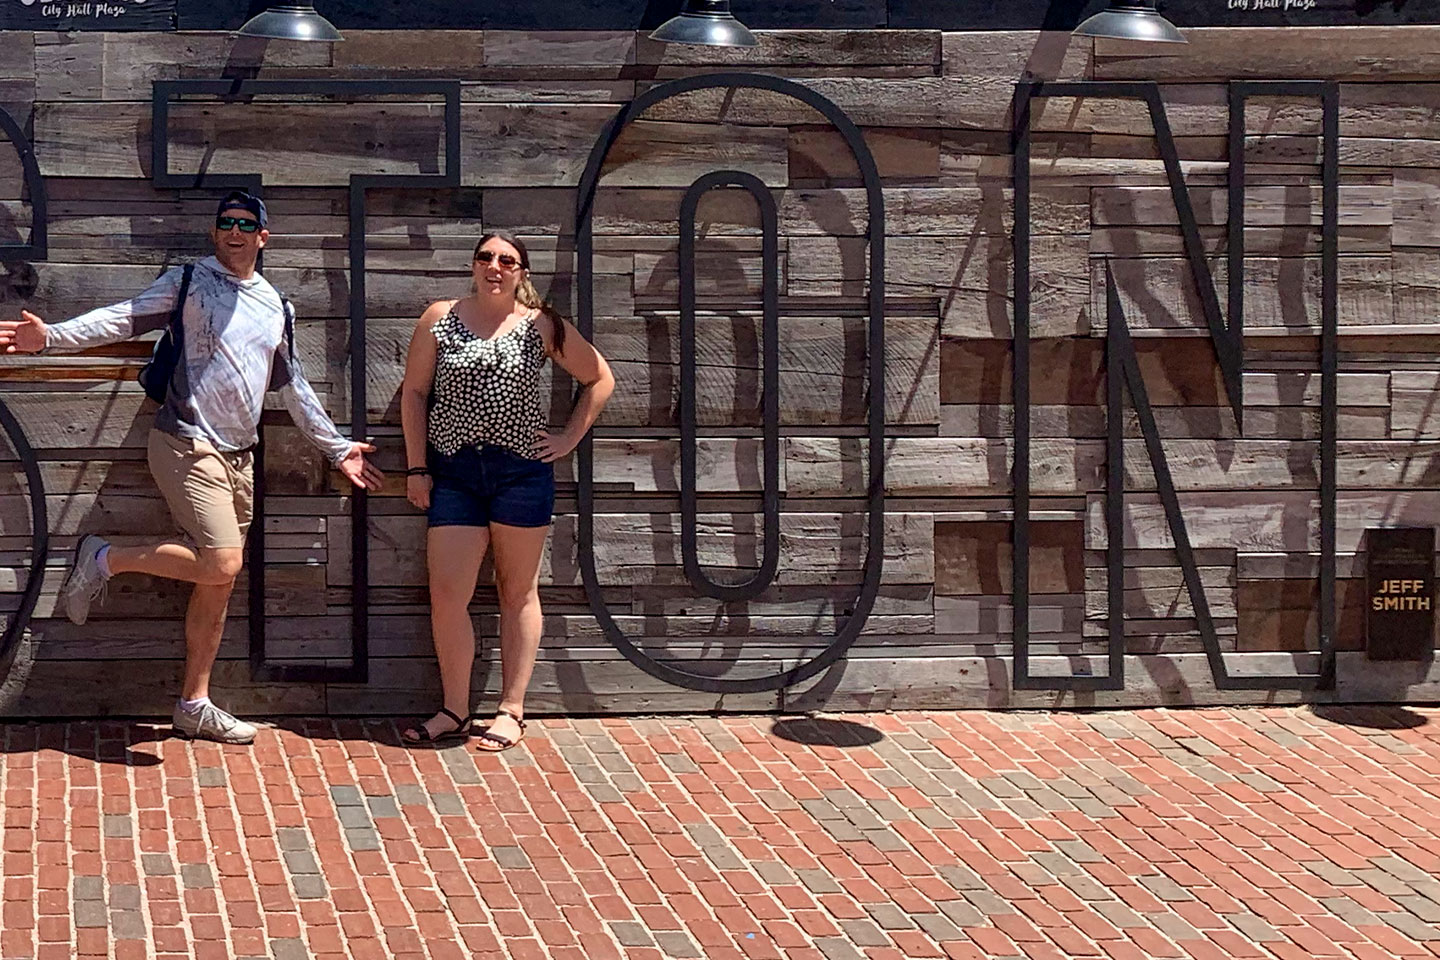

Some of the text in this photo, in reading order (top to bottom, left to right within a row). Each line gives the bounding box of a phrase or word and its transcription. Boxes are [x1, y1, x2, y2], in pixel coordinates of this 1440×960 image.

[42, 5, 61, 17] City
[66, 3, 91, 17] Hall
[1378, 580, 1425, 594] JEFF
[1372, 596, 1431, 611] SMITH
